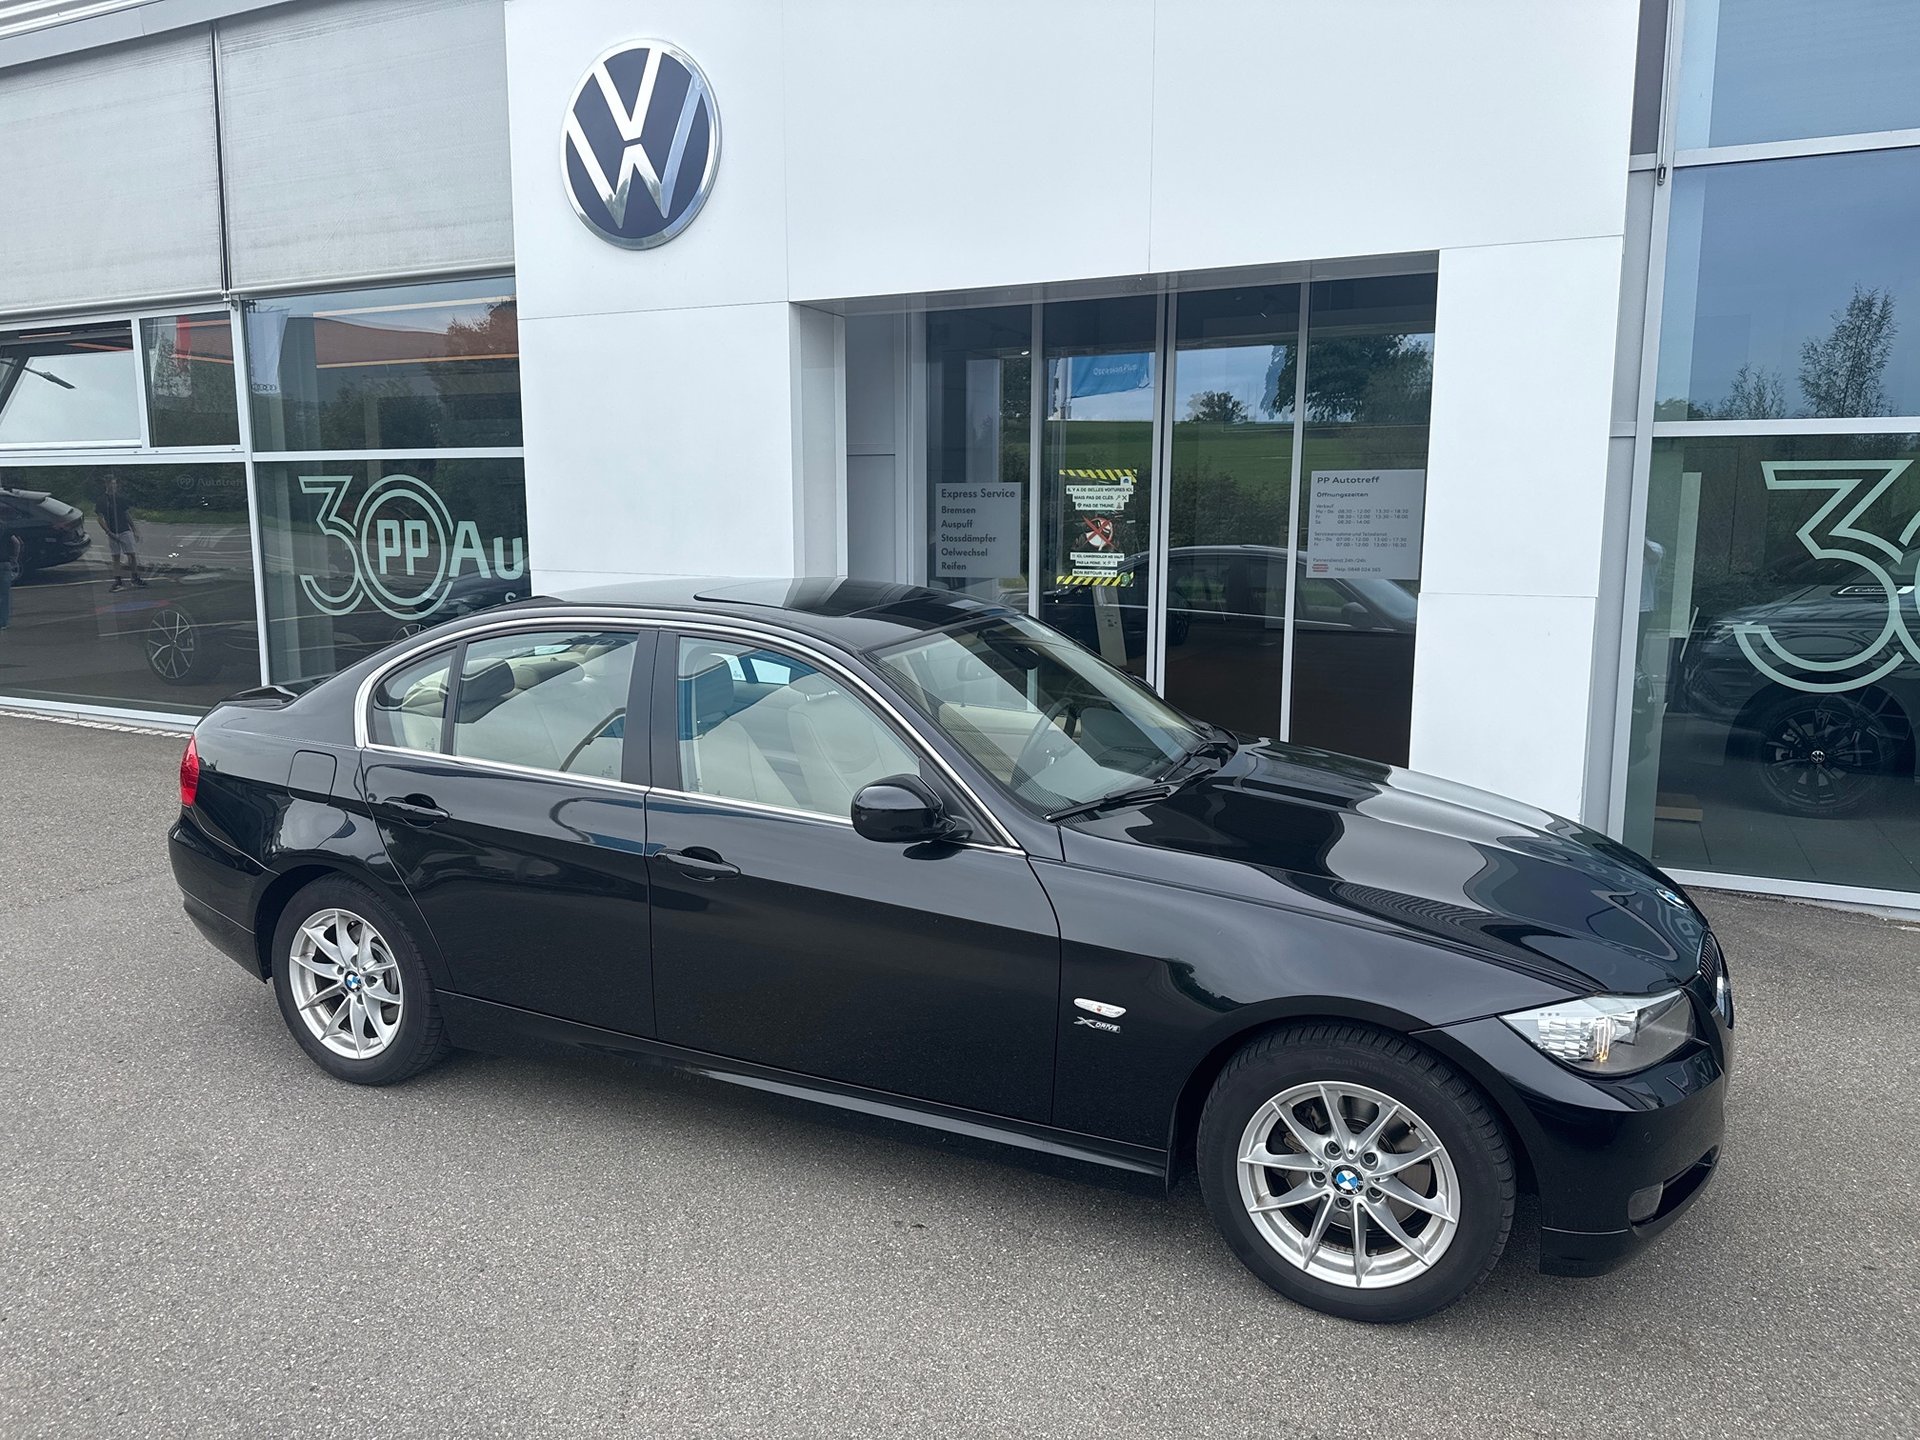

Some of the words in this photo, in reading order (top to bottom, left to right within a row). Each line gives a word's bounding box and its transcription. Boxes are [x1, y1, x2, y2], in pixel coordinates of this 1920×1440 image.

[1332, 476, 1380, 484] Autotreff
[941, 488, 978, 500] Express
[980, 488, 1016, 498] Service
[941, 506, 976, 514] Bremsen
[941, 519, 973, 530] Auspuff
[941, 533, 997, 544] Stossdämpfer
[941, 547, 988, 556] Oelwechsel
[941, 562, 967, 570] Reifen
[1733, 459, 1920, 693] 3
